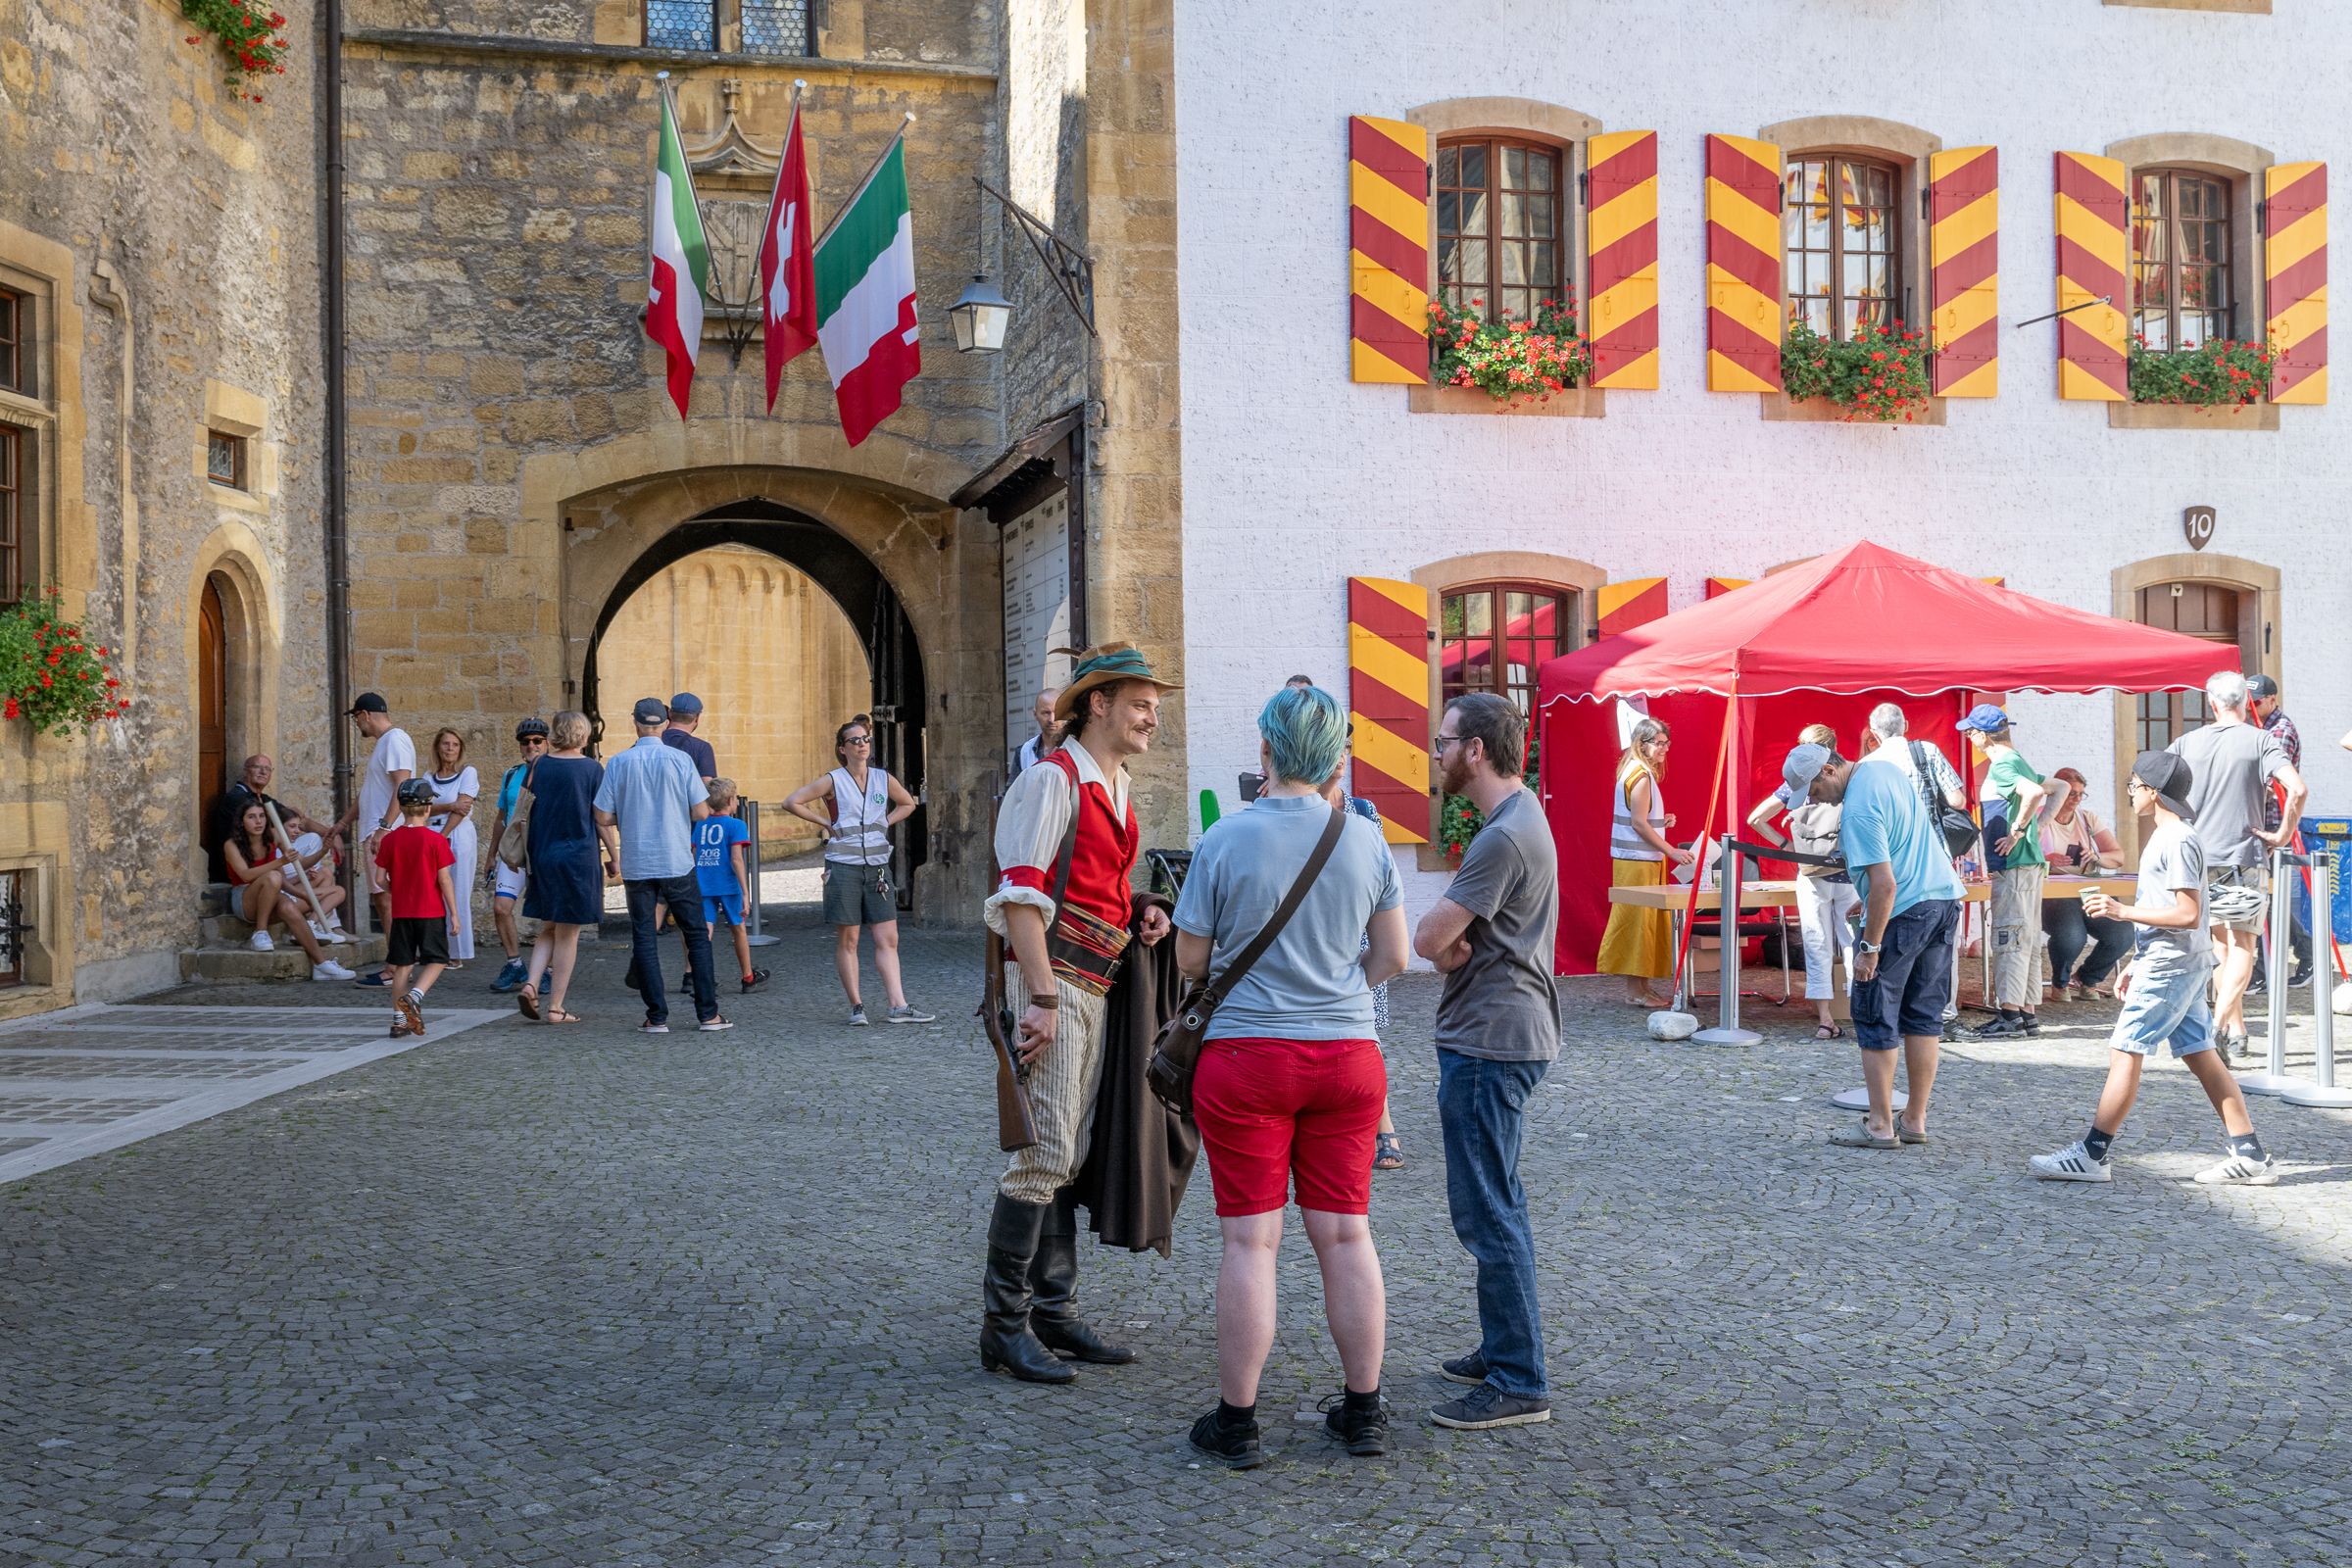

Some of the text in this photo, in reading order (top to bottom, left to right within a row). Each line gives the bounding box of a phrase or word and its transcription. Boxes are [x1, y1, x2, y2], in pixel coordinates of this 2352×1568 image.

[2188, 514, 2212, 539] 10
[701, 824, 723, 845] 10
[700, 848, 720, 858] 2018
